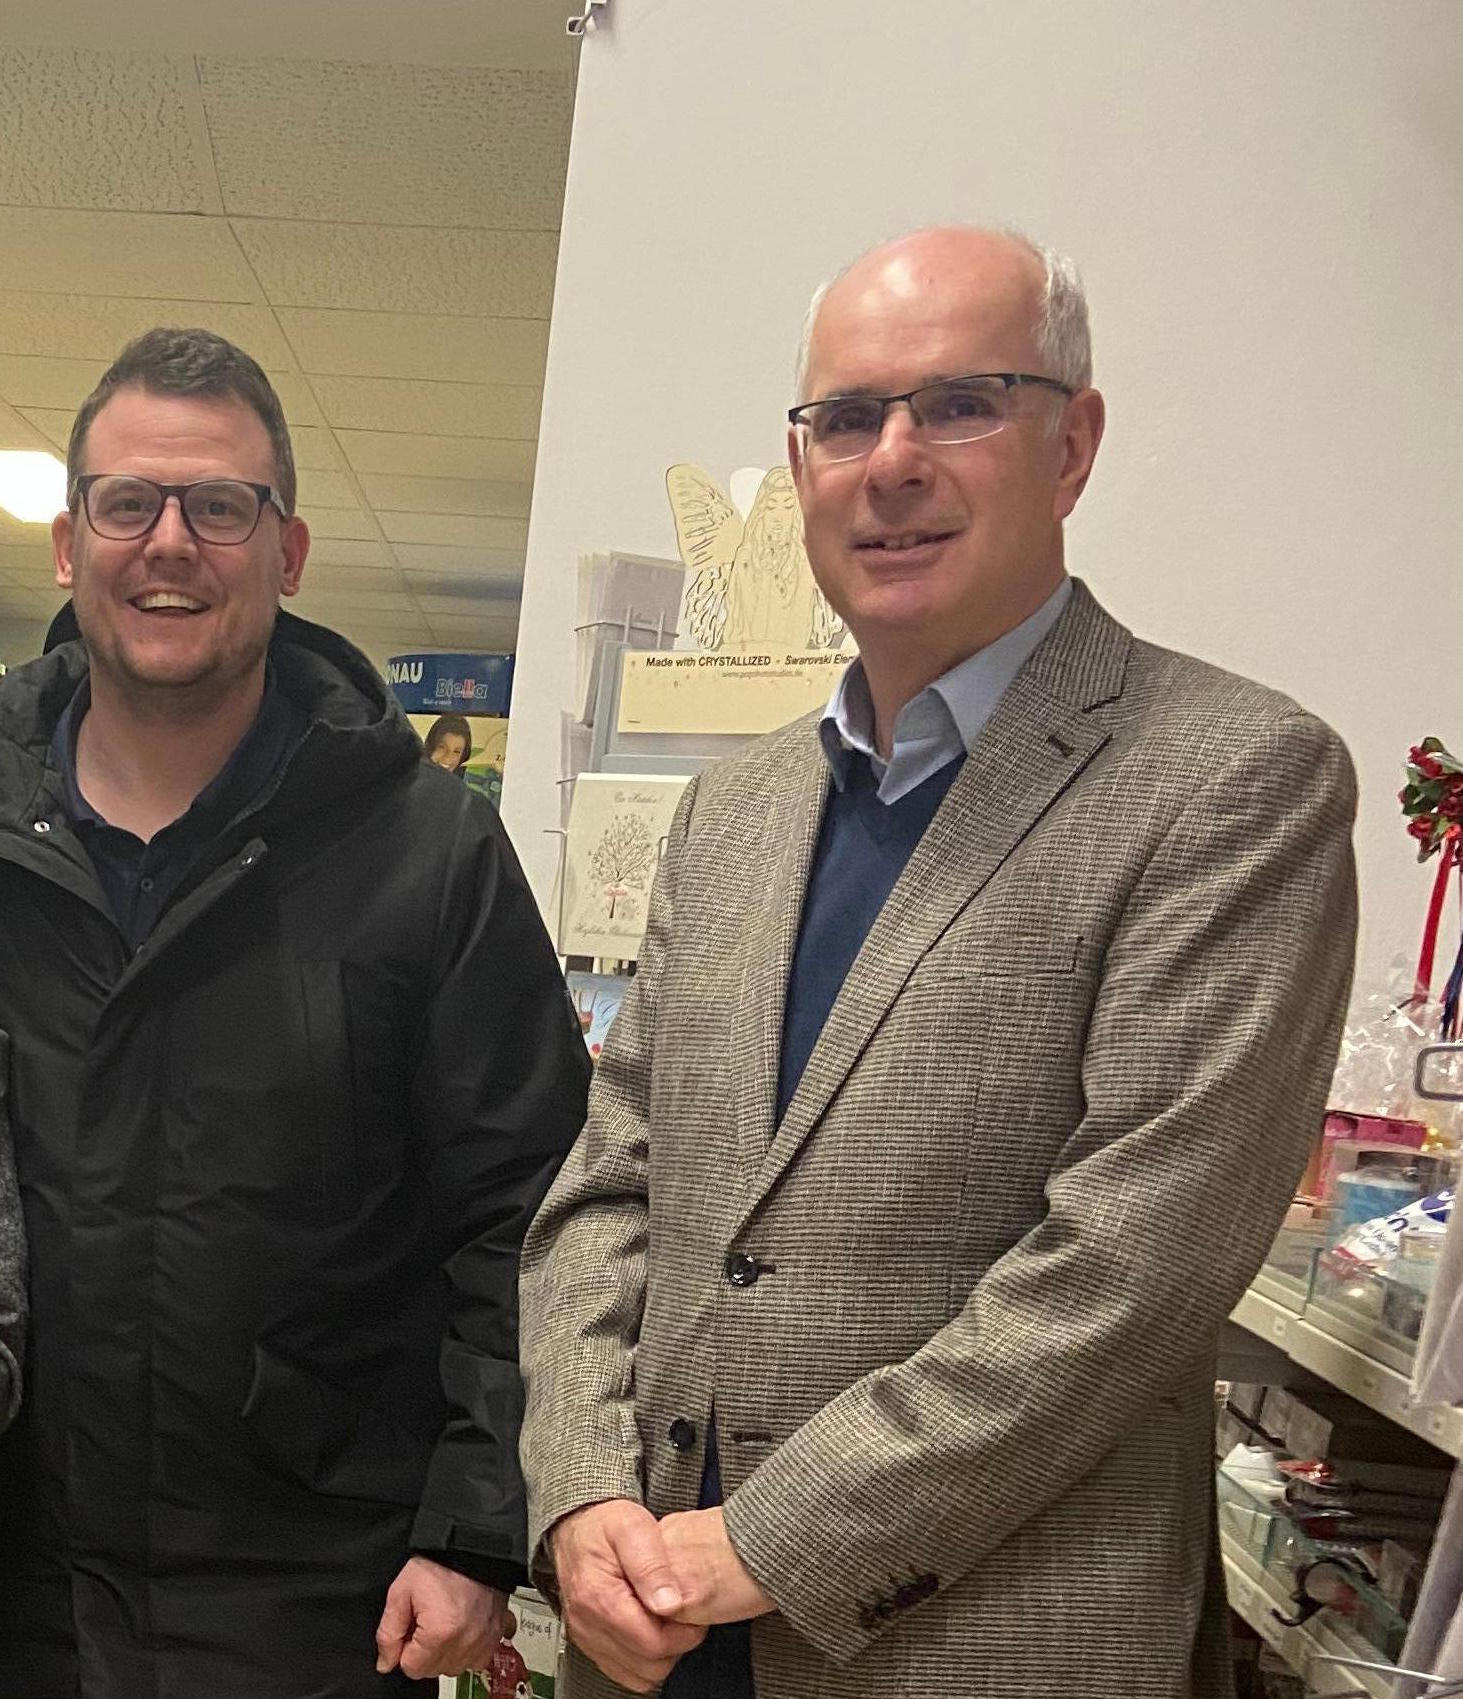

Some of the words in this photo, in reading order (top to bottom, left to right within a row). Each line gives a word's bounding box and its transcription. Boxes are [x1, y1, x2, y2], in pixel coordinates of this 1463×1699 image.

[646, 657, 673, 668] Made
[675, 657, 696, 668] with
[698, 655, 771, 668] CRYSTALLIZED
[784, 654, 832, 666] Swarovski
